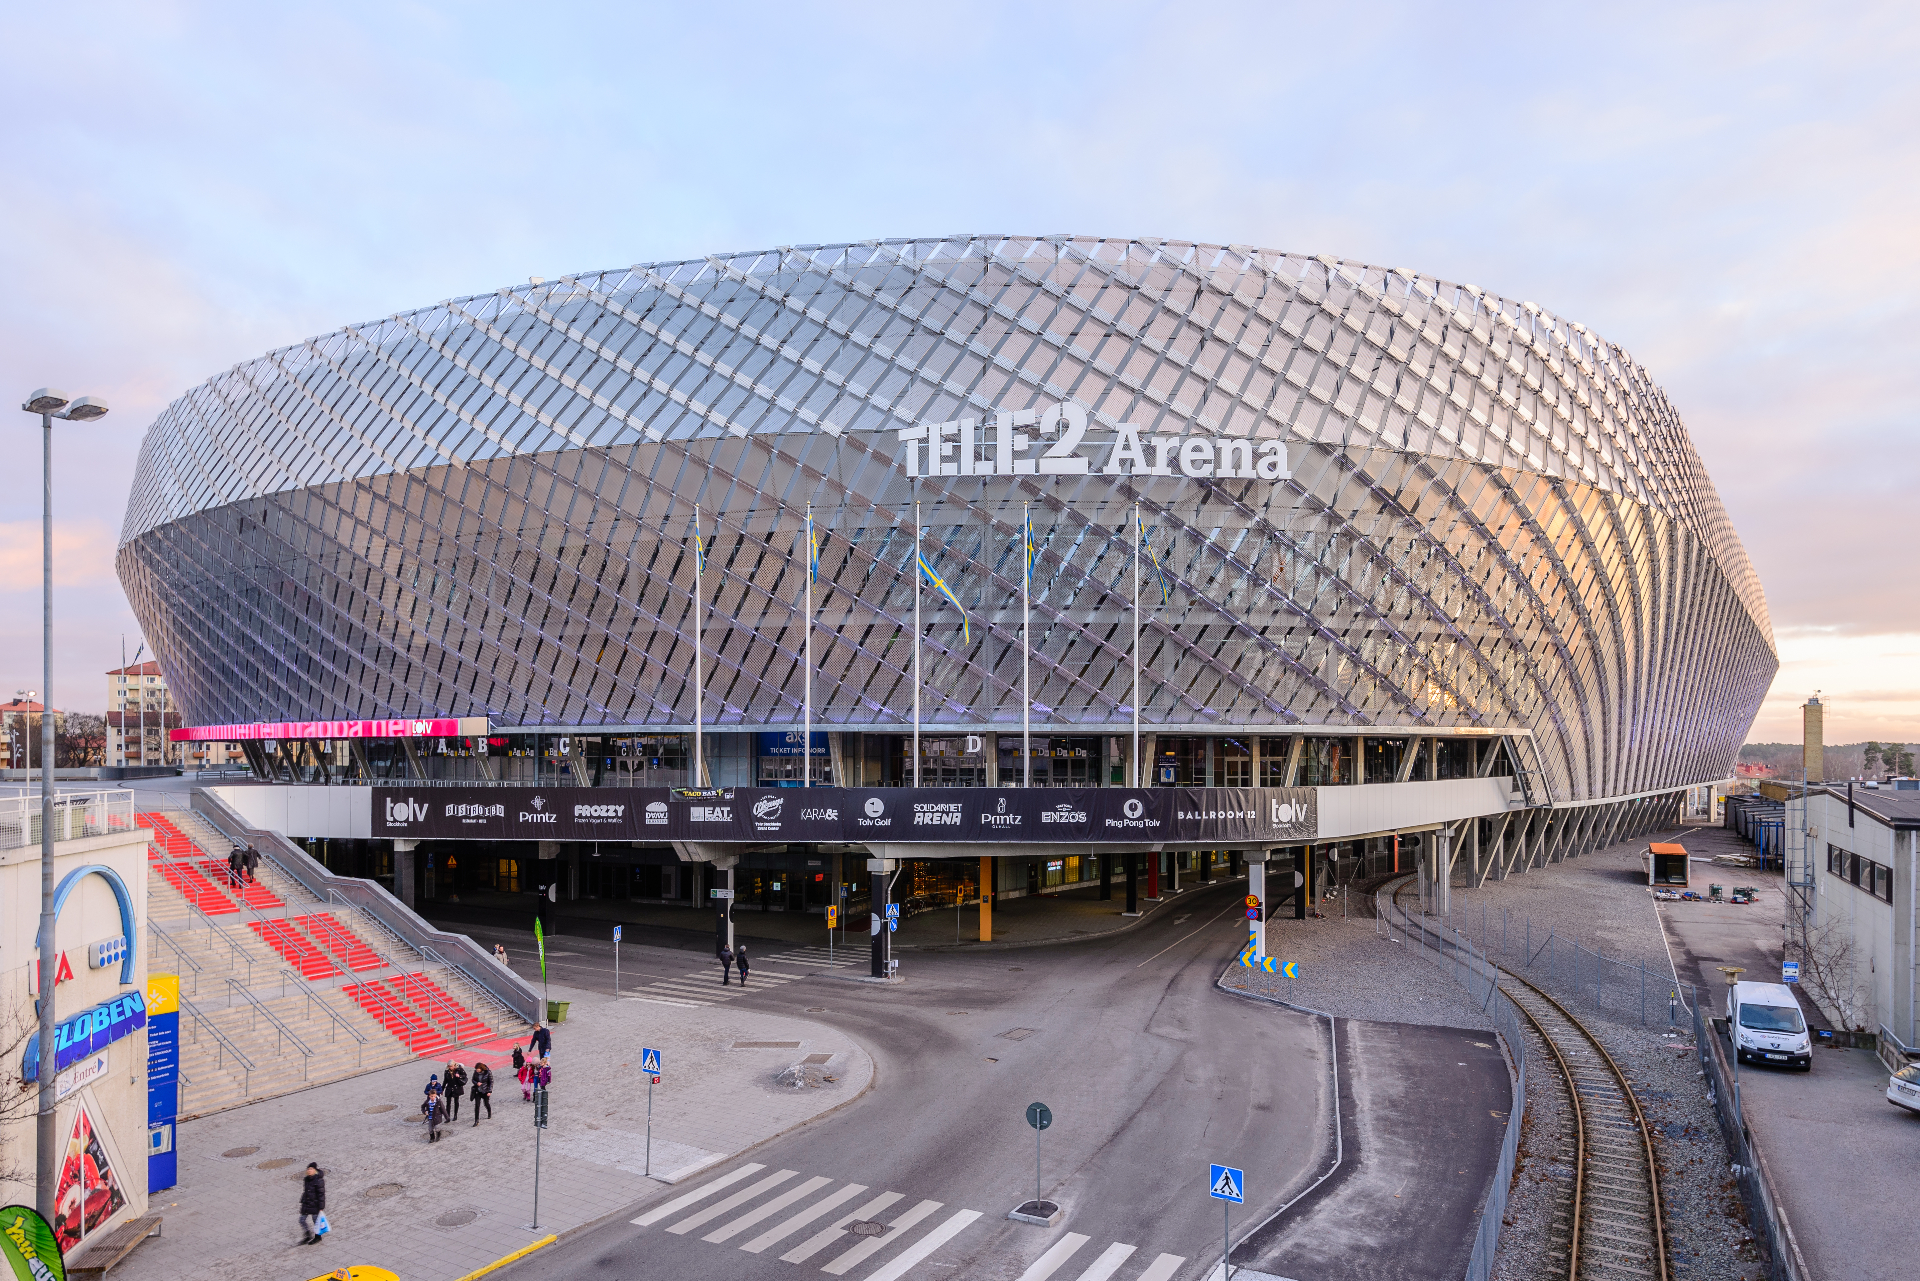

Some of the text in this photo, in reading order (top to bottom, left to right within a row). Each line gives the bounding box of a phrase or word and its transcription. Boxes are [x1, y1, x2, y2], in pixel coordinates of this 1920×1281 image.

[898, 402, 1291, 479] TELE2 Arena
[412, 720, 432, 734] tolv
[437, 738, 447, 753] A
[478, 738, 487, 752] B
[560, 738, 569, 753] C
[967, 736, 981, 752] D
[702, 789, 718, 797] BAR
[386, 797, 429, 821] tolv
[575, 805, 625, 817] FROZZY
[1178, 810, 1256, 820] BALLROOM 12
[1271, 798, 1307, 822] tolv
[519, 811, 557, 823] Printz
[858, 818, 892, 826] Tolv Golf
[913, 812, 962, 826] ARENA
[981, 813, 1022, 825] Printz
[1105, 819, 1161, 828] Ping Pong Tolv
[74, 1061, 97, 1084] Entré
